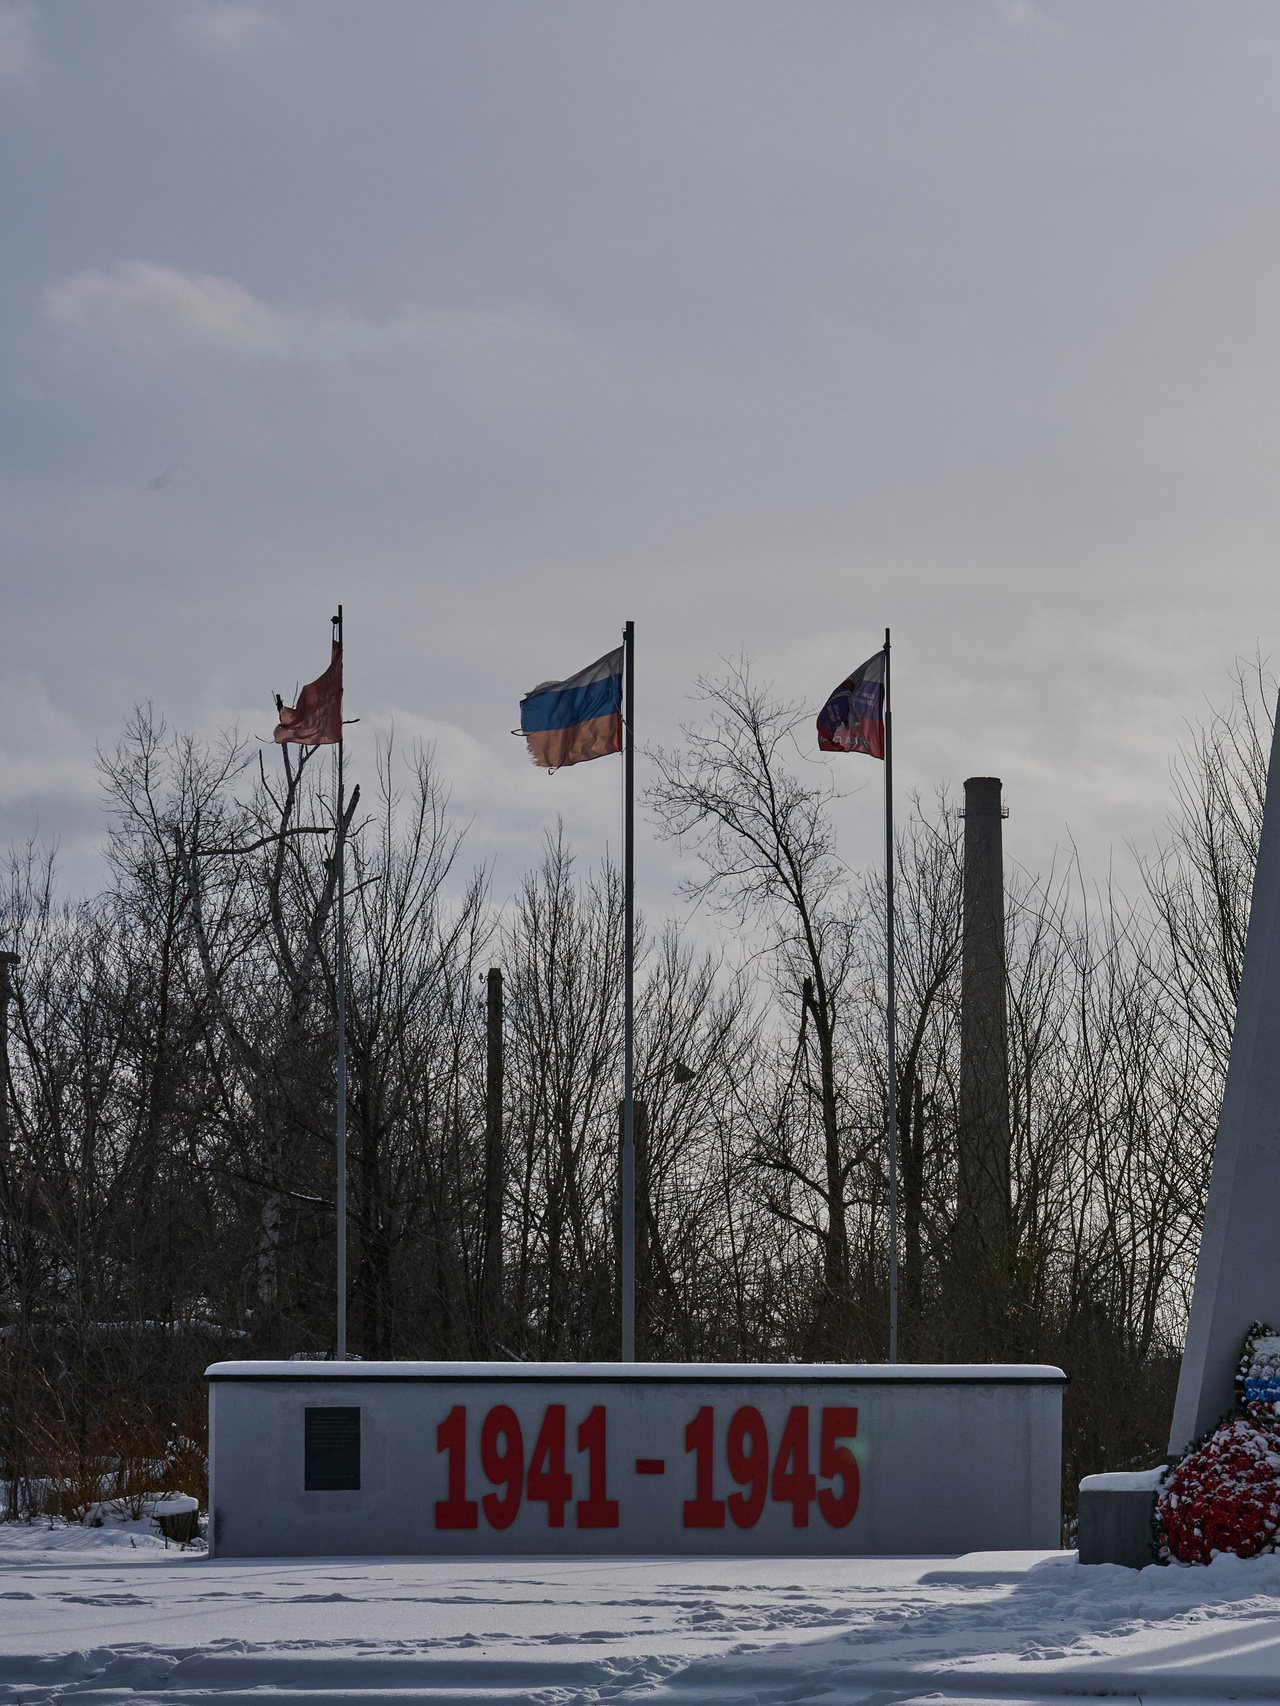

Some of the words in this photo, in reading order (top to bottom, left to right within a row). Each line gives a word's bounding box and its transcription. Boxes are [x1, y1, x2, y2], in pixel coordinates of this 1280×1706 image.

[435, 1404, 619, 1530] 1941
[635, 1459, 665, 1475] -
[683, 1405, 861, 1529] 1945
